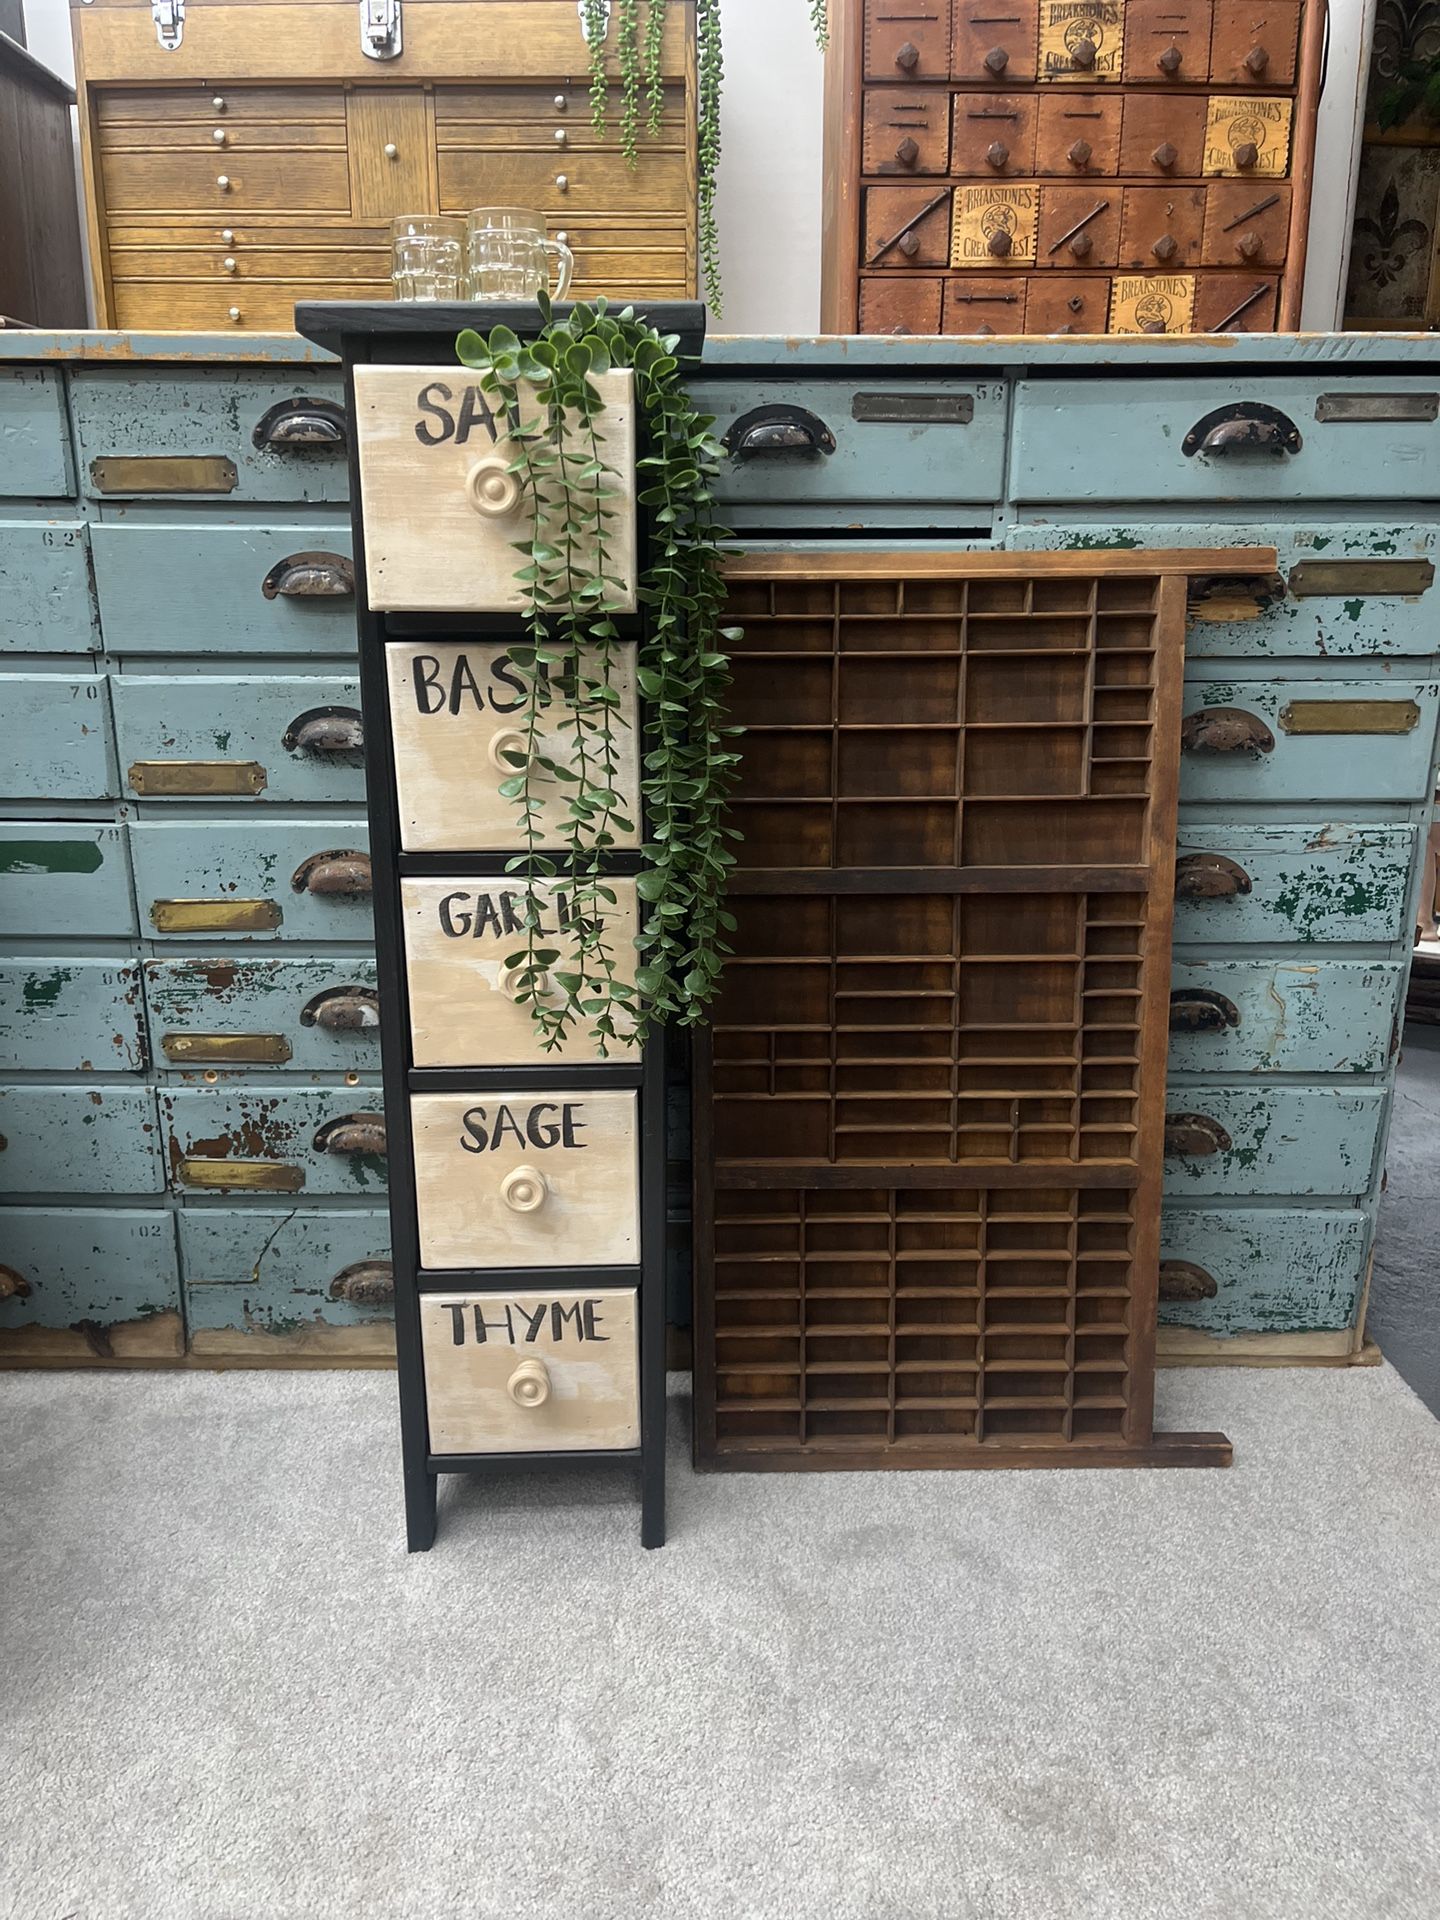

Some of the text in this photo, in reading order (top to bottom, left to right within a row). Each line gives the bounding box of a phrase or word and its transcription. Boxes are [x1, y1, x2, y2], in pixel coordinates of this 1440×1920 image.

[42, 531, 75, 547] 62
[70, 685, 98, 700] 70
[460, 1103, 588, 1153] SAGE
[130, 1225, 161, 1237] 102
[440, 1299, 611, 1346] THYME
